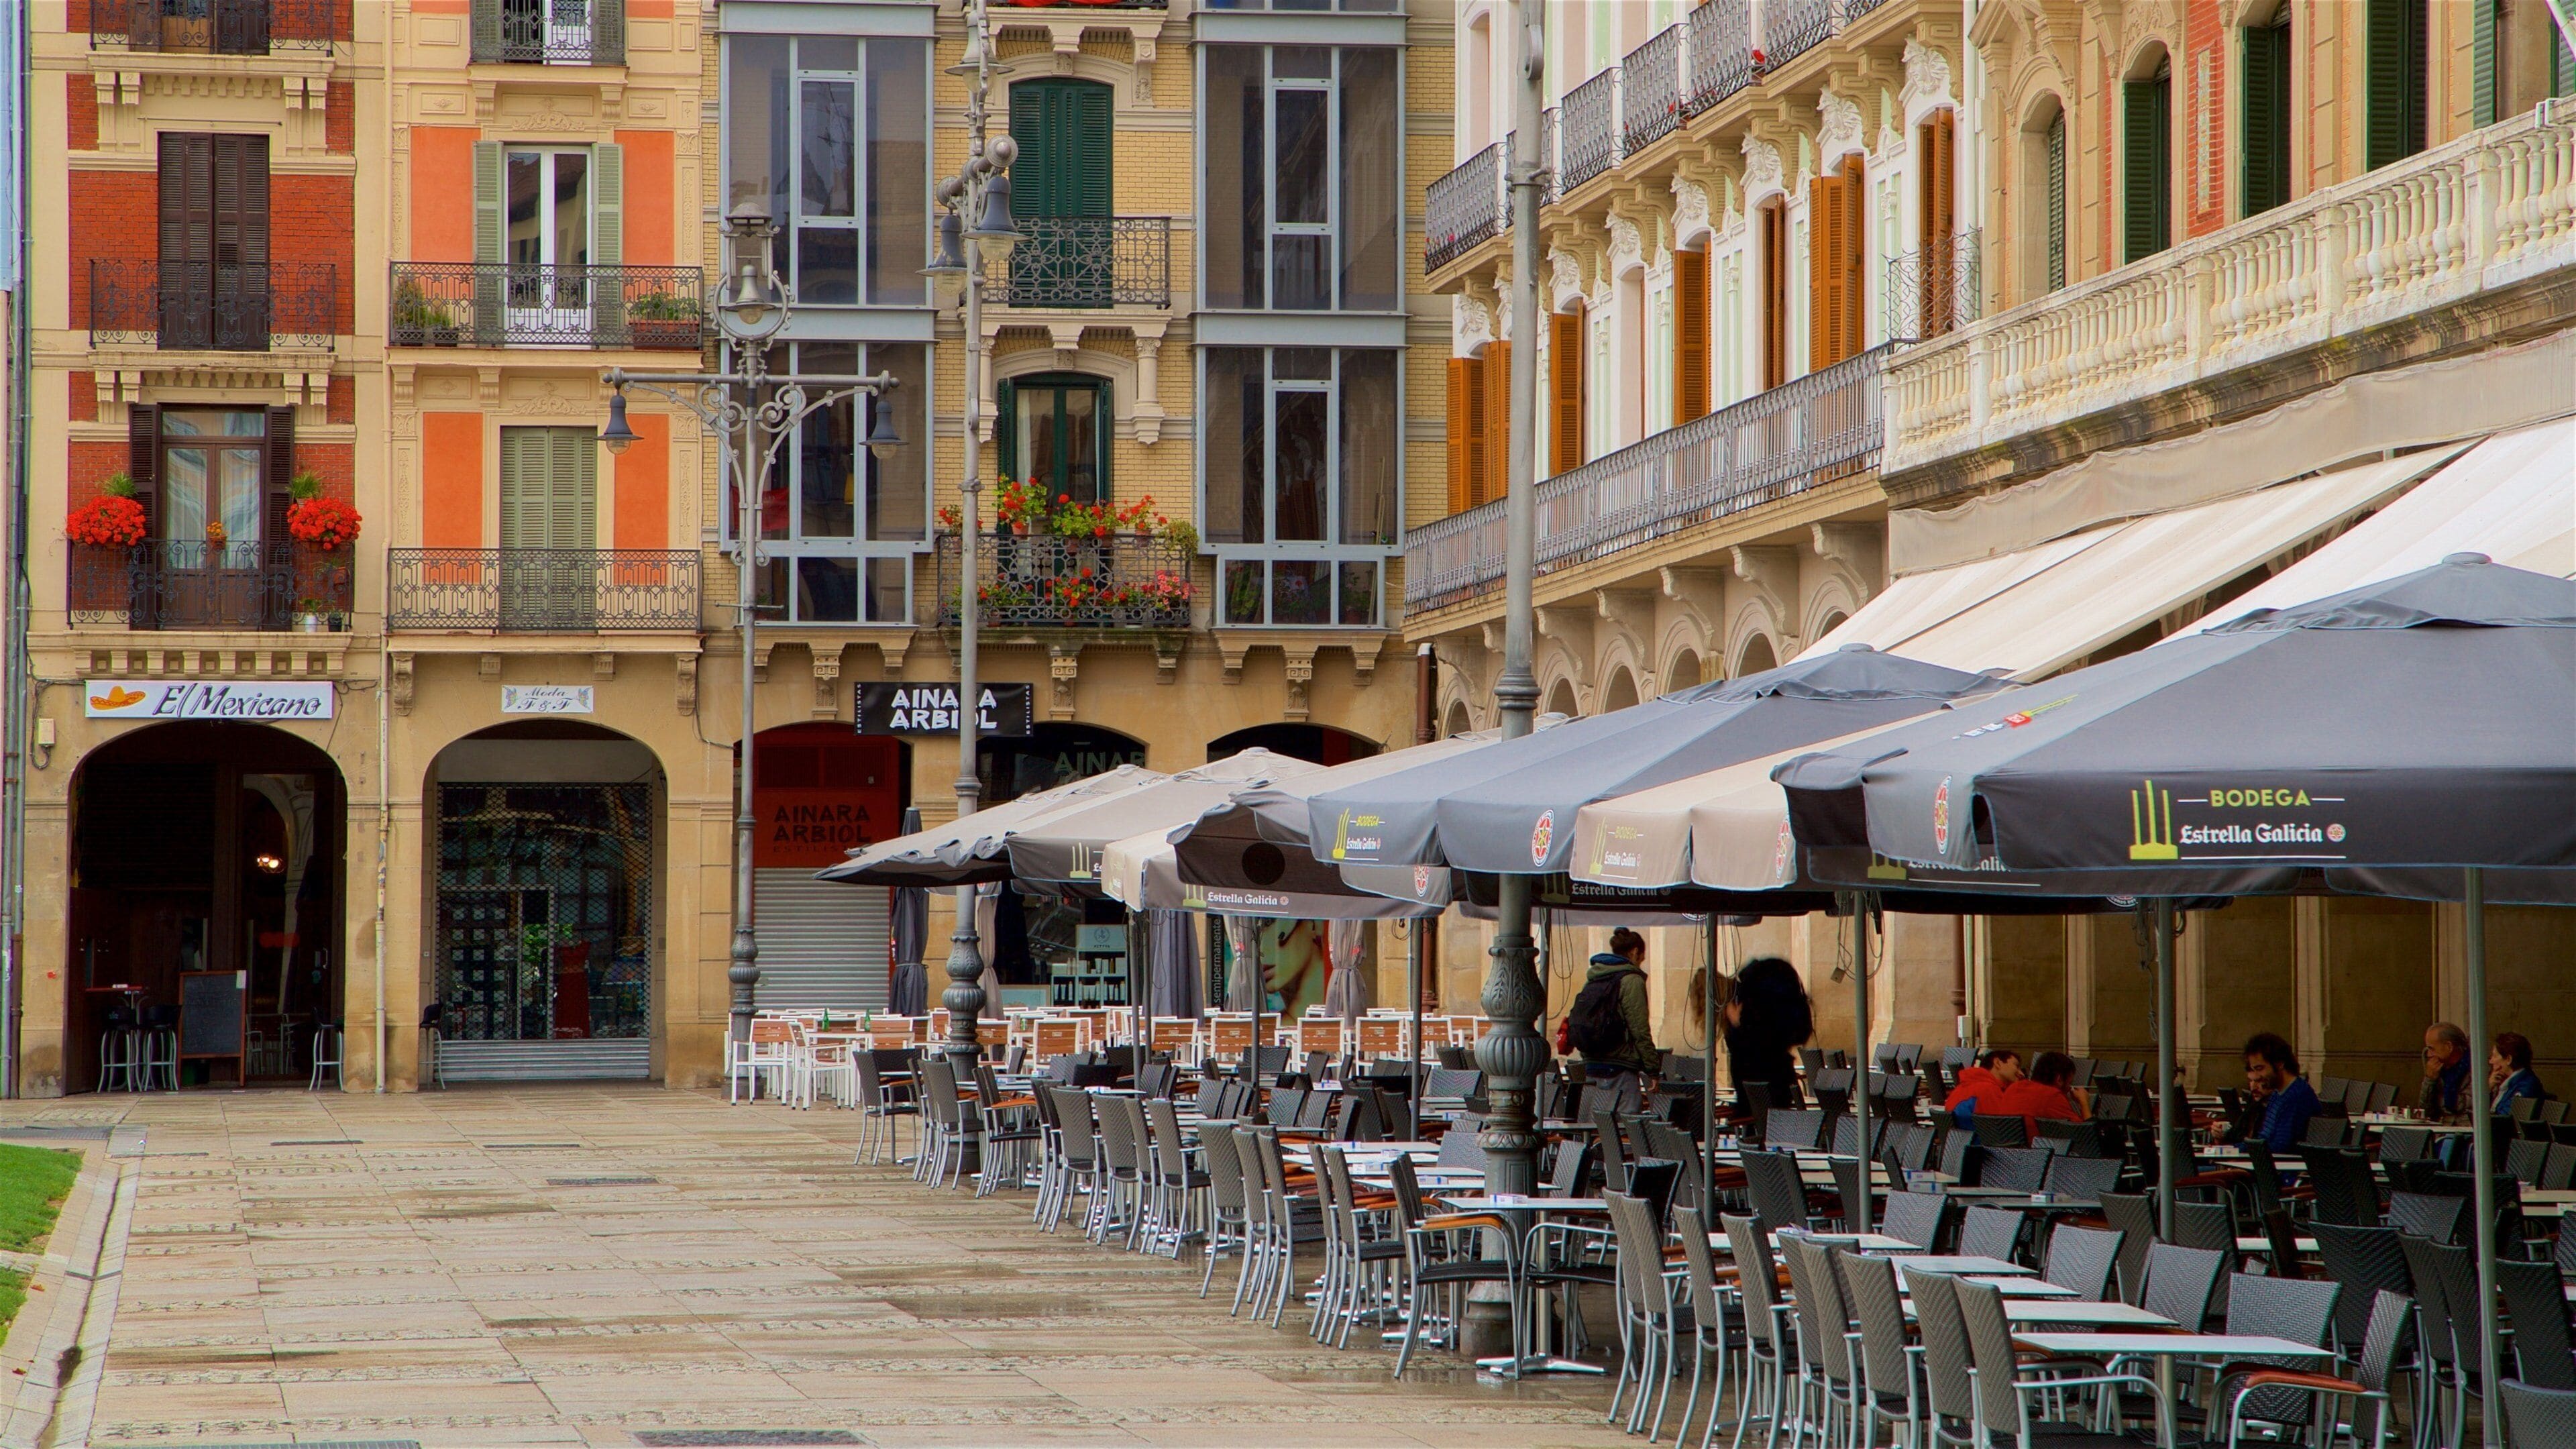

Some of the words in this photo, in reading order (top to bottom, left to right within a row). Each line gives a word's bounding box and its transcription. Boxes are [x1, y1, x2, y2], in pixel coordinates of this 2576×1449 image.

[152, 683, 197, 717] El
[189, 685, 321, 716] Mexicano
[525, 687, 566, 697] Moda
[892, 688, 997, 709] AINAA
[539, 700, 551, 712] &
[890, 709, 997, 730] ARBIL
[2210, 789, 2311, 807] BODEGA
[774, 804, 870, 823] AINARA
[773, 824, 871, 843] ARBIOL
[2180, 824, 2253, 844] Estrella
[2255, 823, 2323, 843] Galicia
[1208, 892, 1243, 904] Estrella
[1244, 894, 1278, 906] Galicia
[1572, 883, 1615, 896] Estrella
[1212, 918, 1222, 1003] semipermanente
